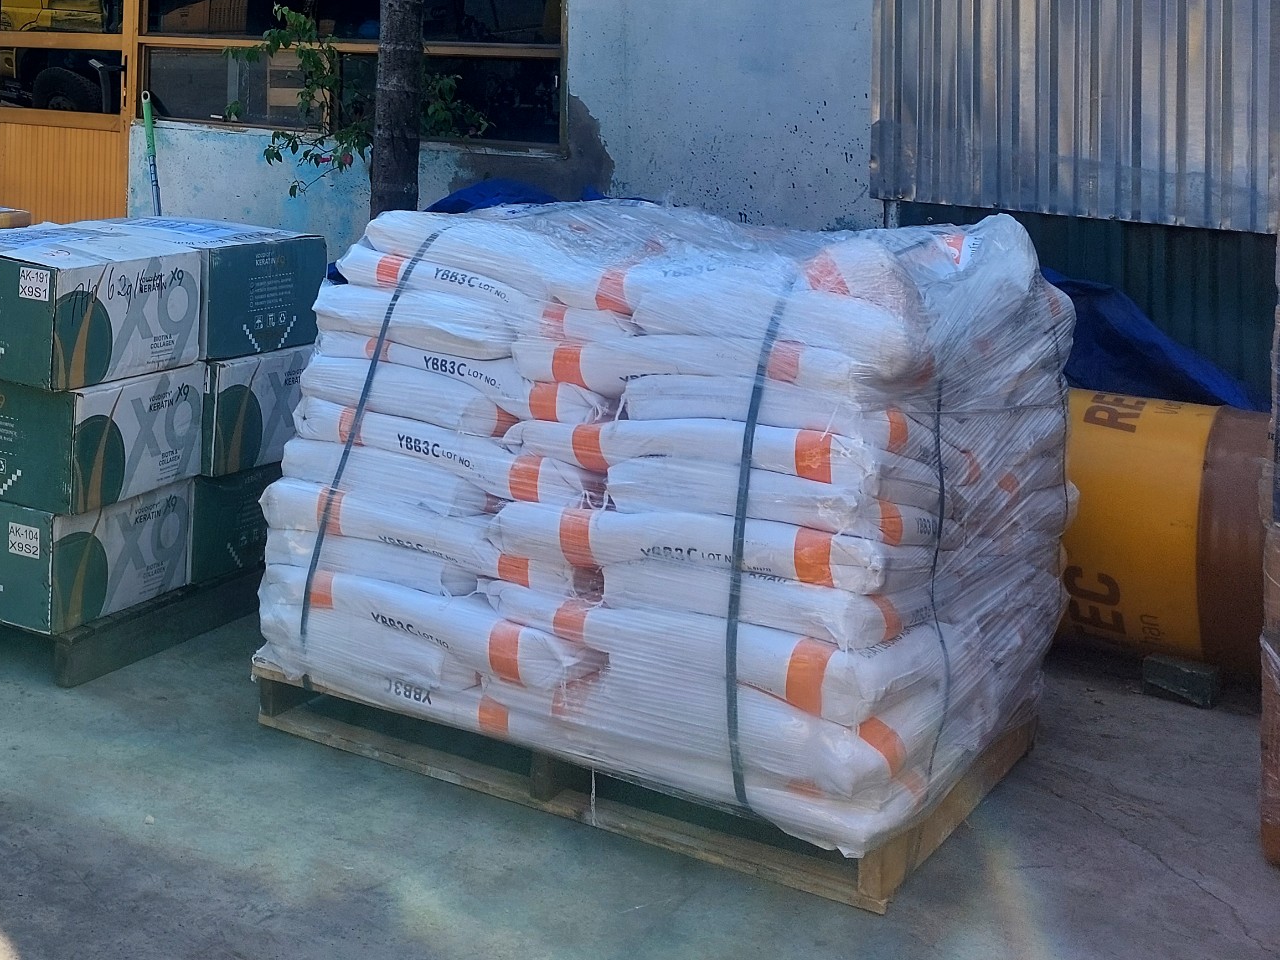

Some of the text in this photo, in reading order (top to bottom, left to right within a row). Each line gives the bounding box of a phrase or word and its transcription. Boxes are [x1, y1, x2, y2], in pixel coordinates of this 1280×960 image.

[20, 269, 49, 284] AK-191
[434, 267, 479, 287] YBB3C
[479, 282, 495, 292] LOT
[19, 285, 48, 300] X9S1
[150, 339, 175, 349] COLLAGEN
[153, 335, 168, 343] BIOTIN
[423, 355, 466, 377] YBB3C
[467, 369, 483, 380] LOT
[149, 382, 190, 413] KERATIN X9
[397, 433, 441, 458] YBB3C
[442, 449, 456, 460] LOT
[134, 494, 177, 525] KERATIN X9
[9, 526, 39, 541] AK-104
[9, 541, 39, 556] X9S2
